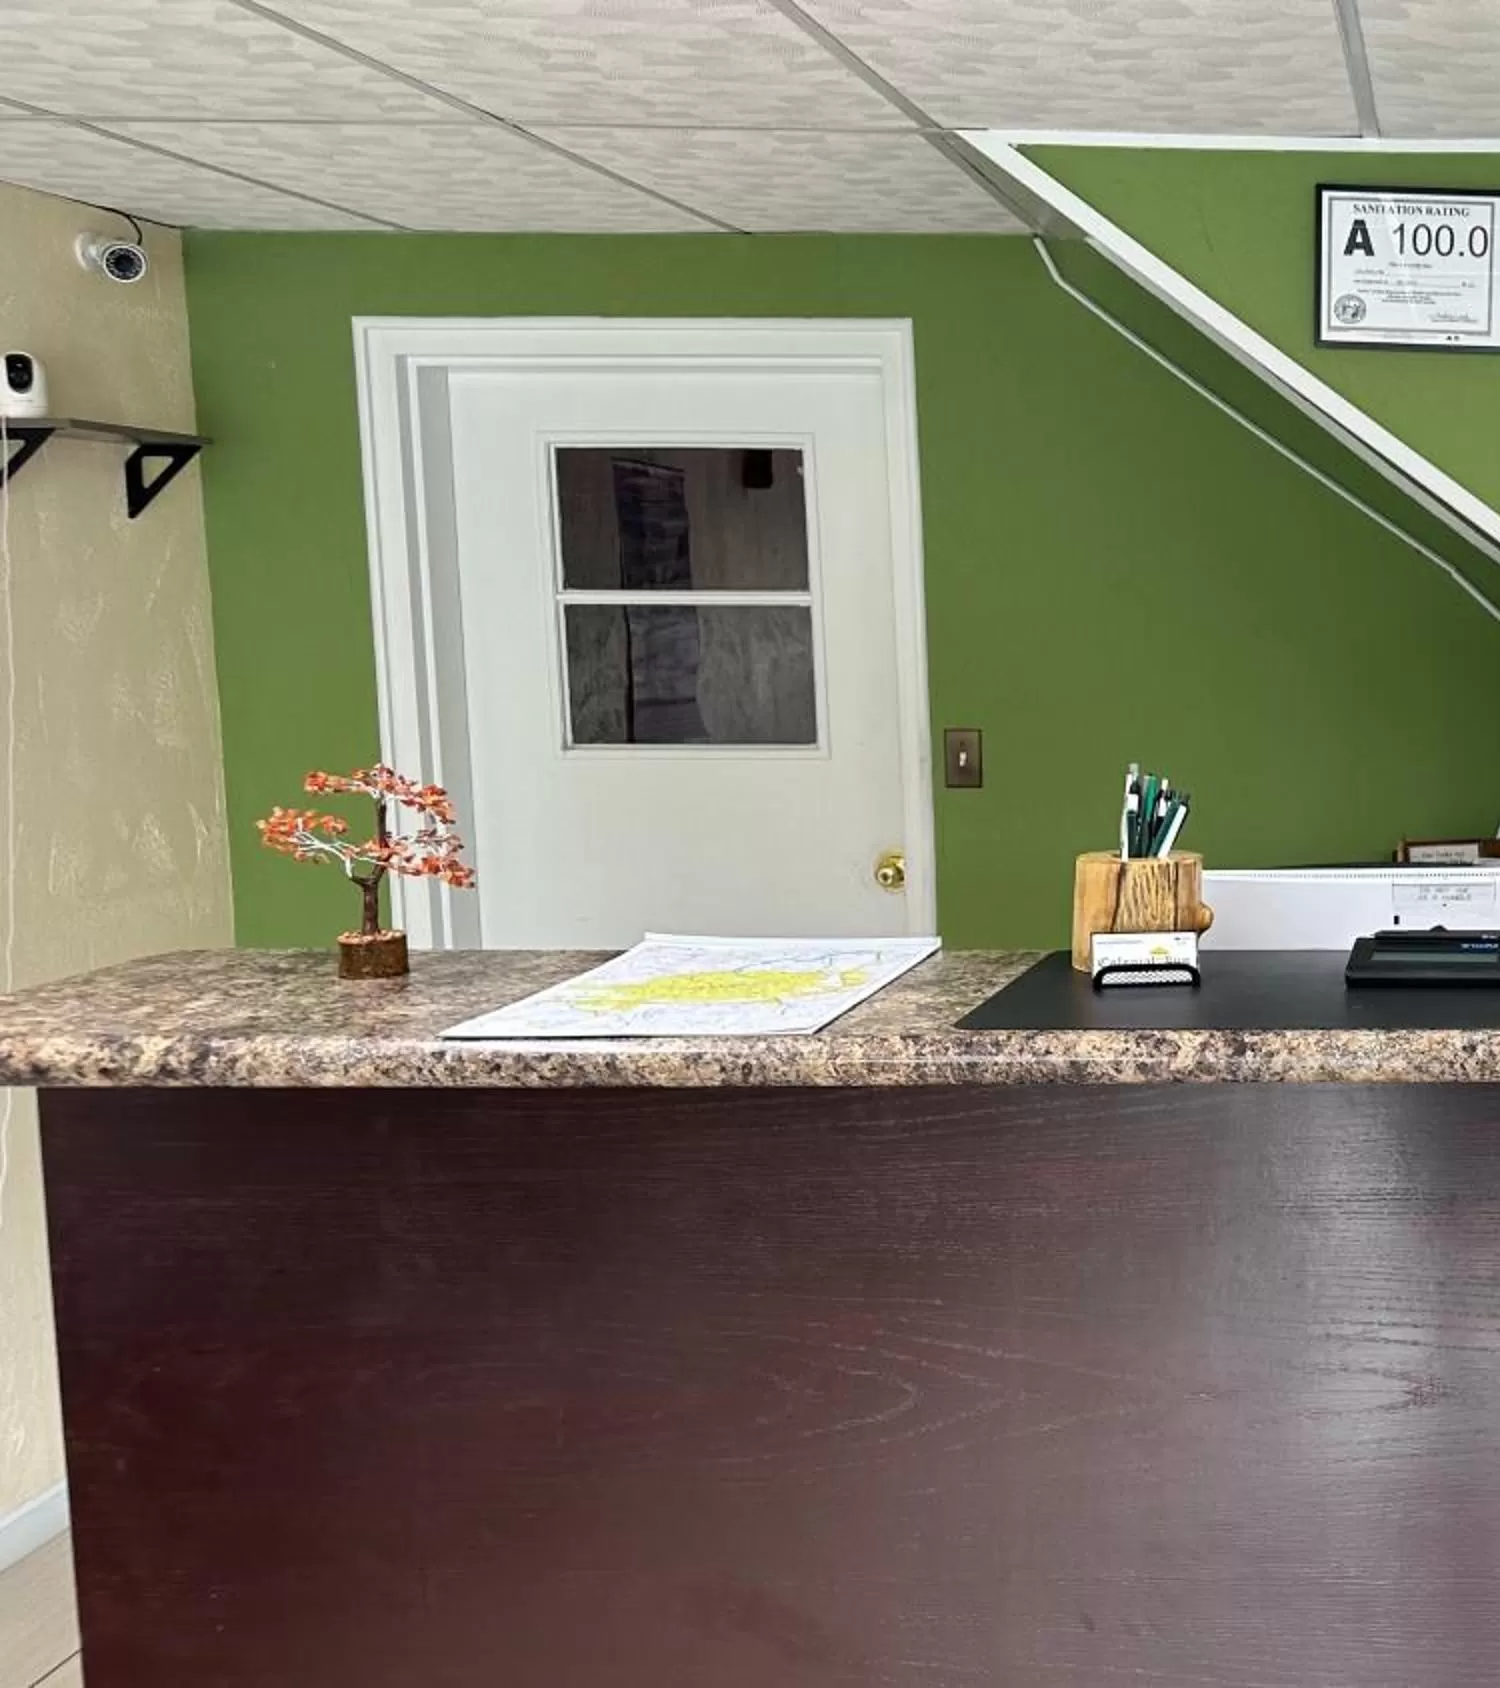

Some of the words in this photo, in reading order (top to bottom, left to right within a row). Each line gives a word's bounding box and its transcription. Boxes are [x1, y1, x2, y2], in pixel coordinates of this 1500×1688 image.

[1353, 204, 1423, 216] SANITATION
[1425, 206, 1470, 217] RATING
[1343, 219, 1375, 257] A
[1392, 222, 1489, 258] 100.0
